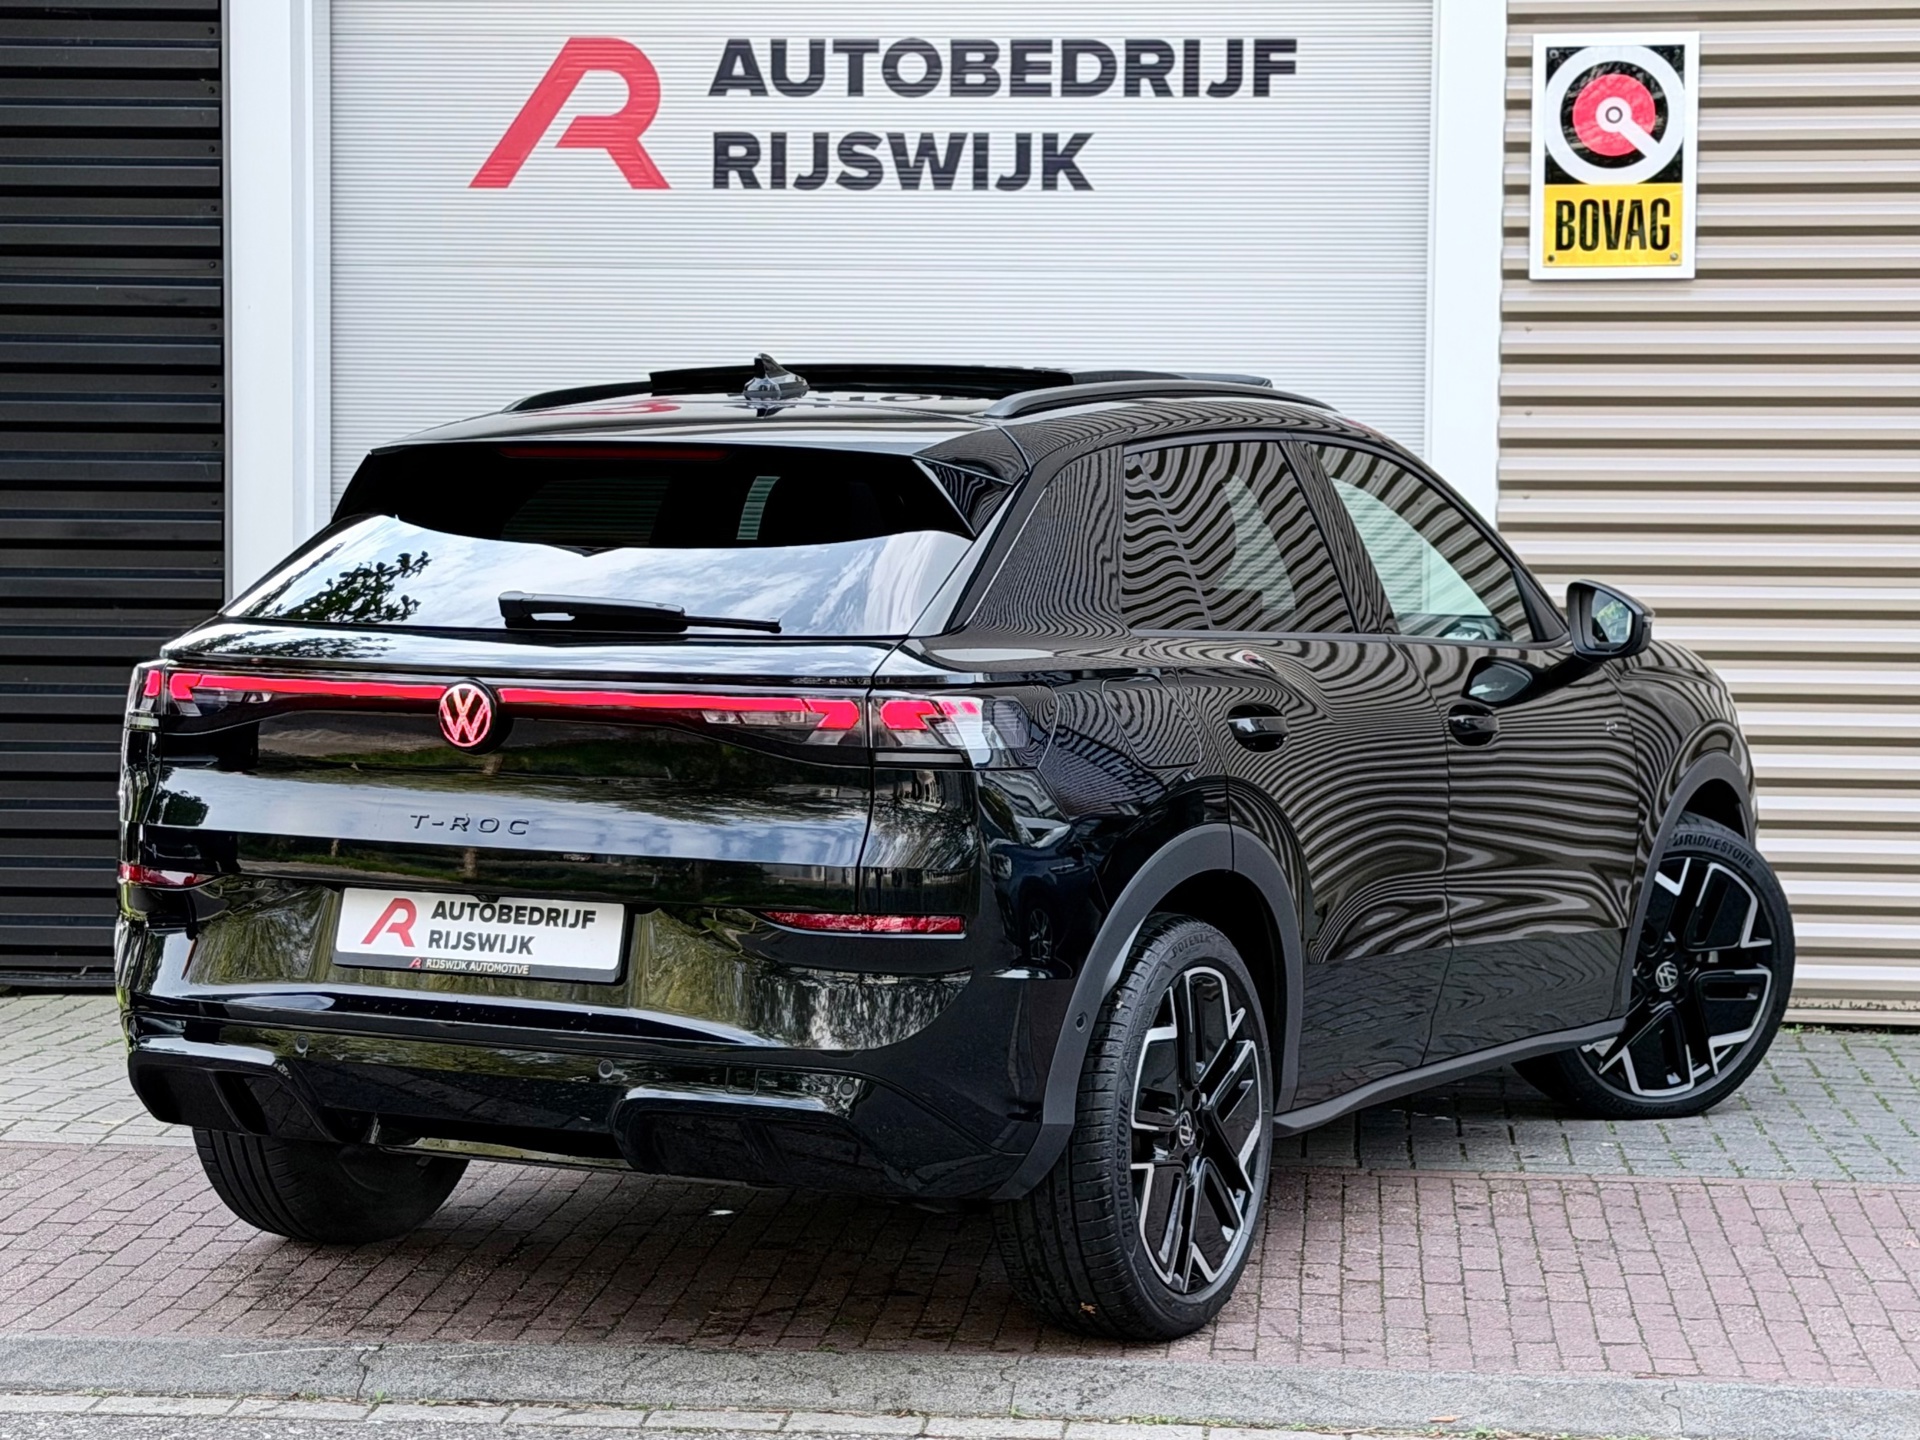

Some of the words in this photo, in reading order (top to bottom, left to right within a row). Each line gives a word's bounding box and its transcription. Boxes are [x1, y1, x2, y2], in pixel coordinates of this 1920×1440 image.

[708, 38, 1297, 98] AUTOBEDRIJF
[713, 132, 1094, 191] RIJSWIJK
[1555, 198, 1671, 251] BOVAG
[410, 814, 529, 835] T-ROC
[431, 900, 597, 929] AUTOBEDRIJF
[428, 929, 535, 955] RIJSWIJK
[426, 958, 468, 970] RIJSWIJK
[468, 961, 530, 975] AUTOMOTIVE
[1116, 1093, 1134, 1238] BRIDGESTONE
